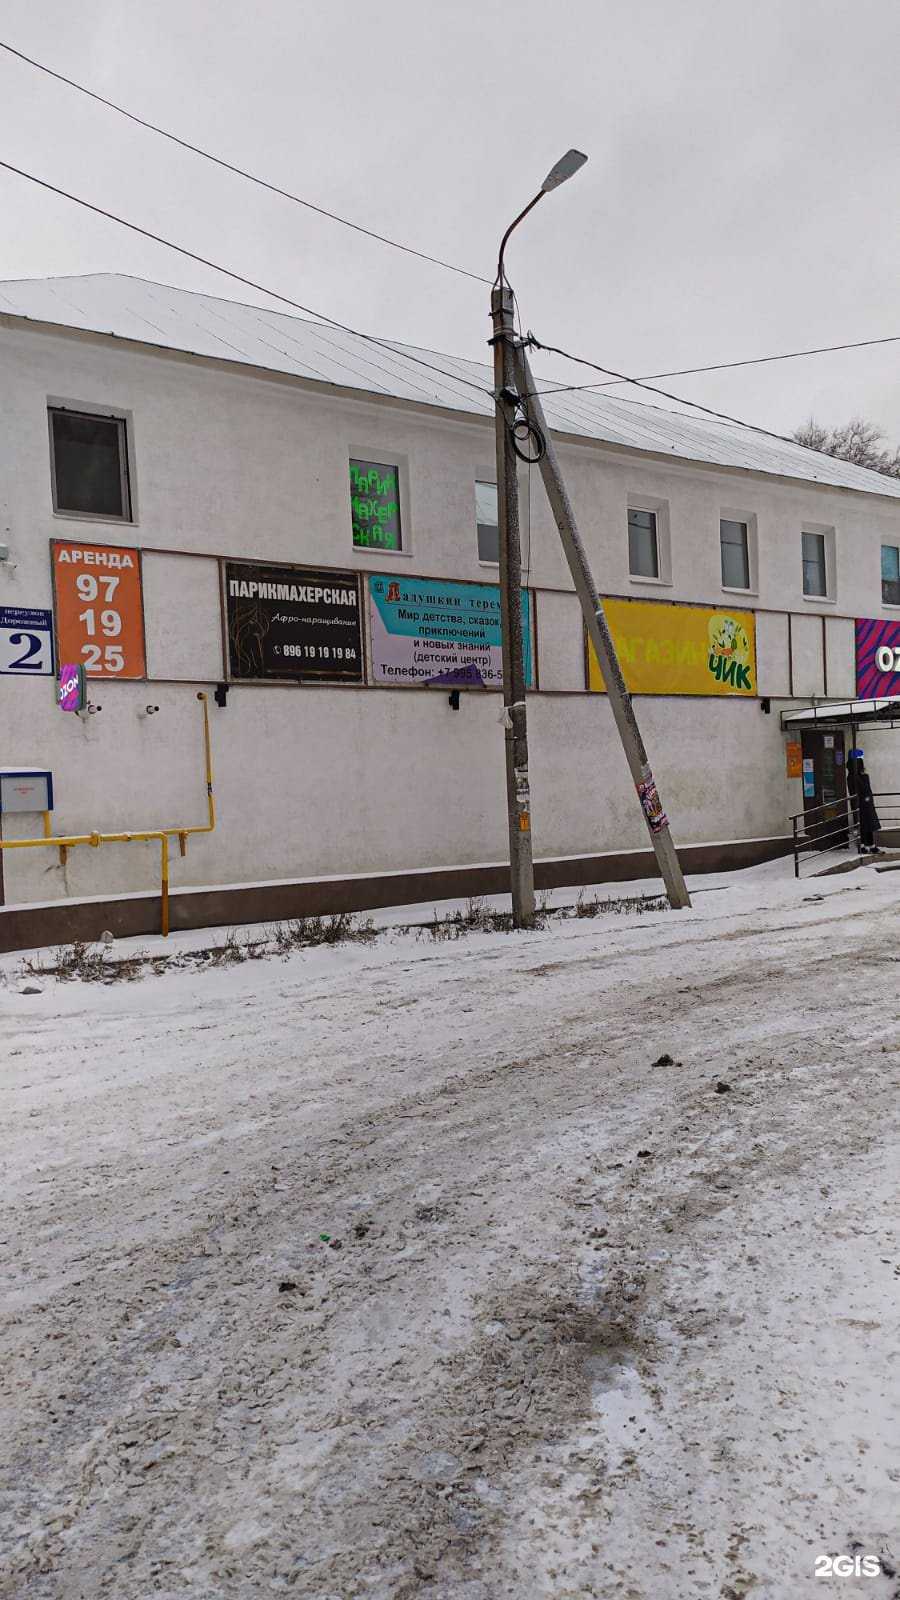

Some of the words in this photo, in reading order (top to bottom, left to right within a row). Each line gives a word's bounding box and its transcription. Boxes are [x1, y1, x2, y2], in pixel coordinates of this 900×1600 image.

[58, 550, 134, 569] АРЕНДА
[76, 574, 120, 602] 97
[229, 580, 357, 606] ПАРИКМАХЕРСКАЯ
[79, 608, 122, 637] 19
[271, 613, 357, 626] Афро-наращивание
[398, 609, 420, 622] Мир
[422, 612, 466, 625] детства,
[8, 633, 43, 669] 2
[283, 645, 302, 657] 896
[304, 646, 316, 658] 19
[318, 647, 330, 658] 19
[332, 648, 343, 659] 19
[345, 648, 357, 659] 84
[423, 640, 454, 649] новых
[457, 641, 491, 651] знаний
[614, 635, 706, 665] АГАЗИН
[81, 644, 125, 672] 25
[413, 651, 458, 664] (детский
[460, 654, 492, 667] центр)
[380, 664, 434, 678] Телефон:
[708, 653, 752, 690] ЧИК
